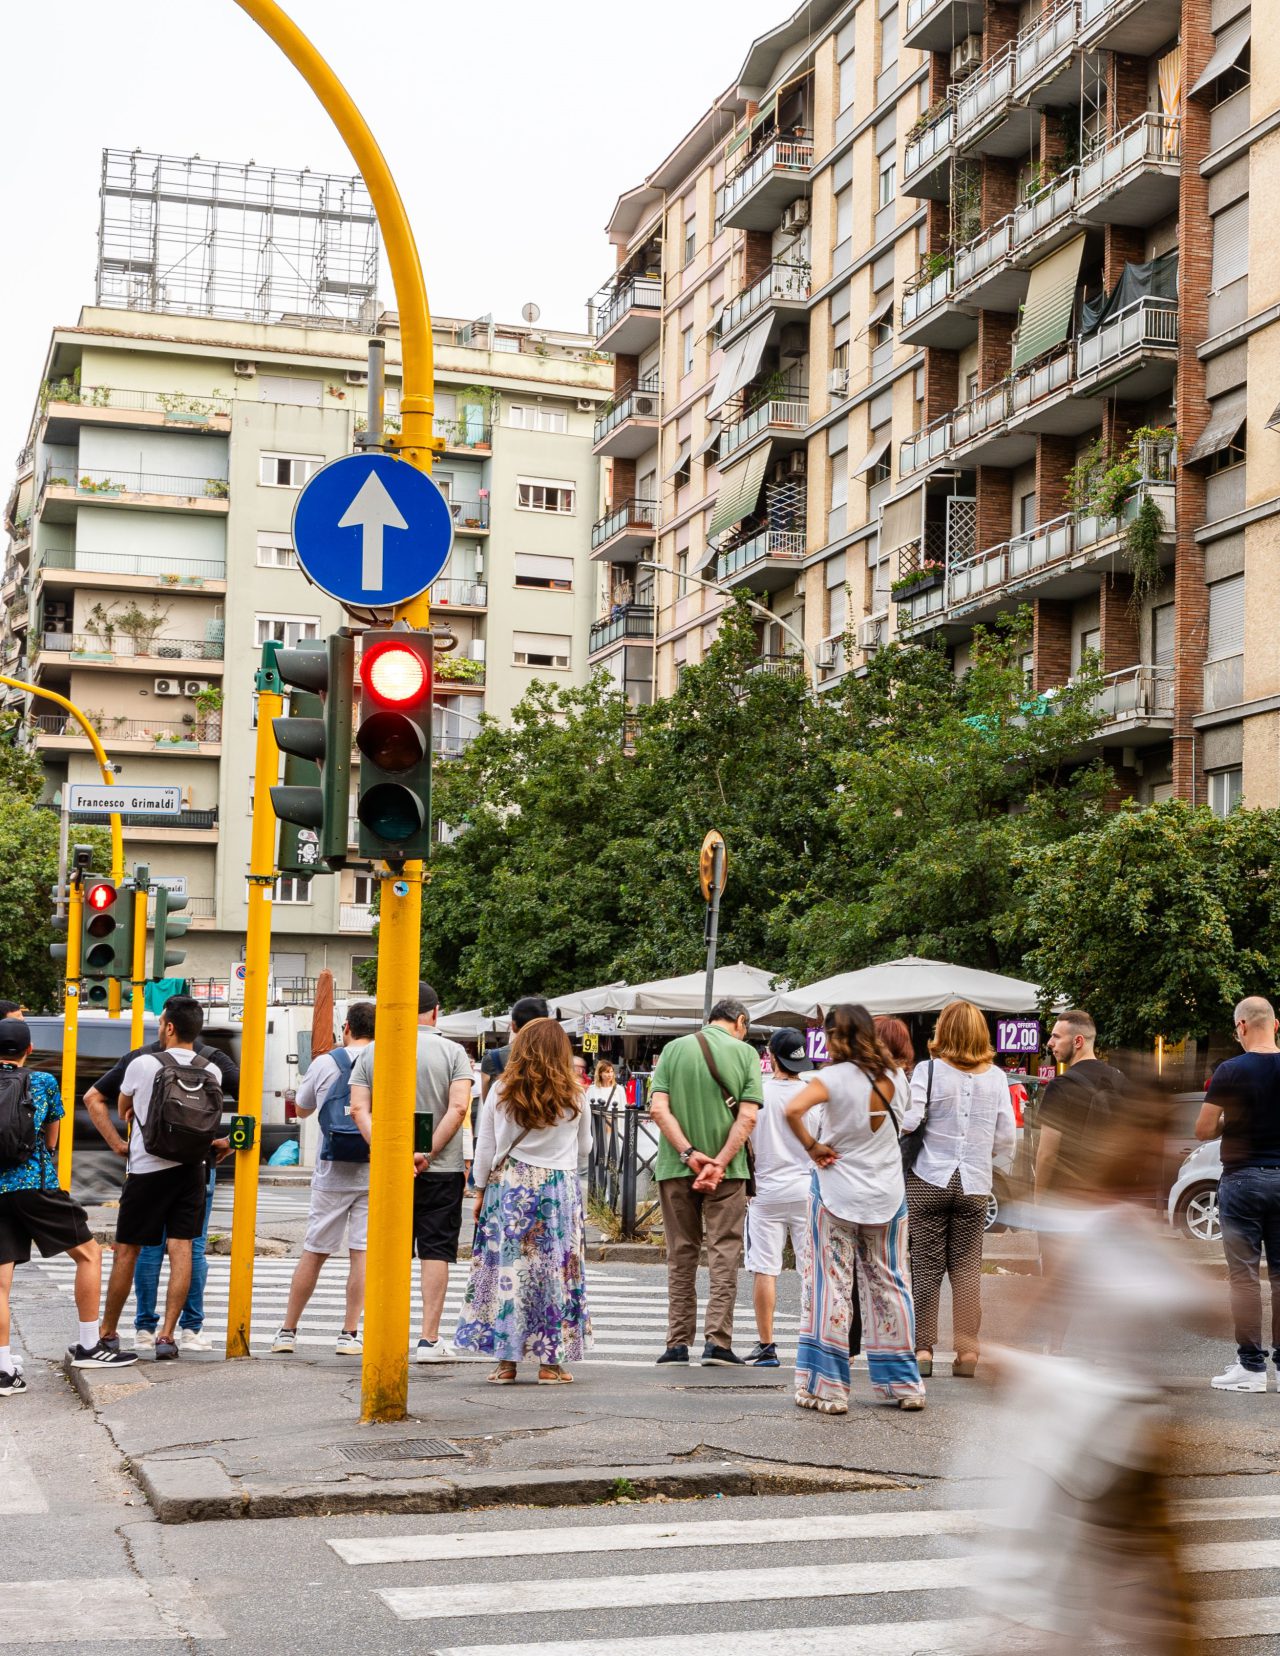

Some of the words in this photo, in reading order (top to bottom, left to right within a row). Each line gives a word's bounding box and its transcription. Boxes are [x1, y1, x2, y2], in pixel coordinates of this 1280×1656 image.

[77, 796, 125, 808] Francesco
[131, 798, 174, 809] Grimaldi
[616, 1016, 623, 1029] 2
[999, 1023, 1037, 1050] 12,00
[584, 1038, 592, 1051] 9
